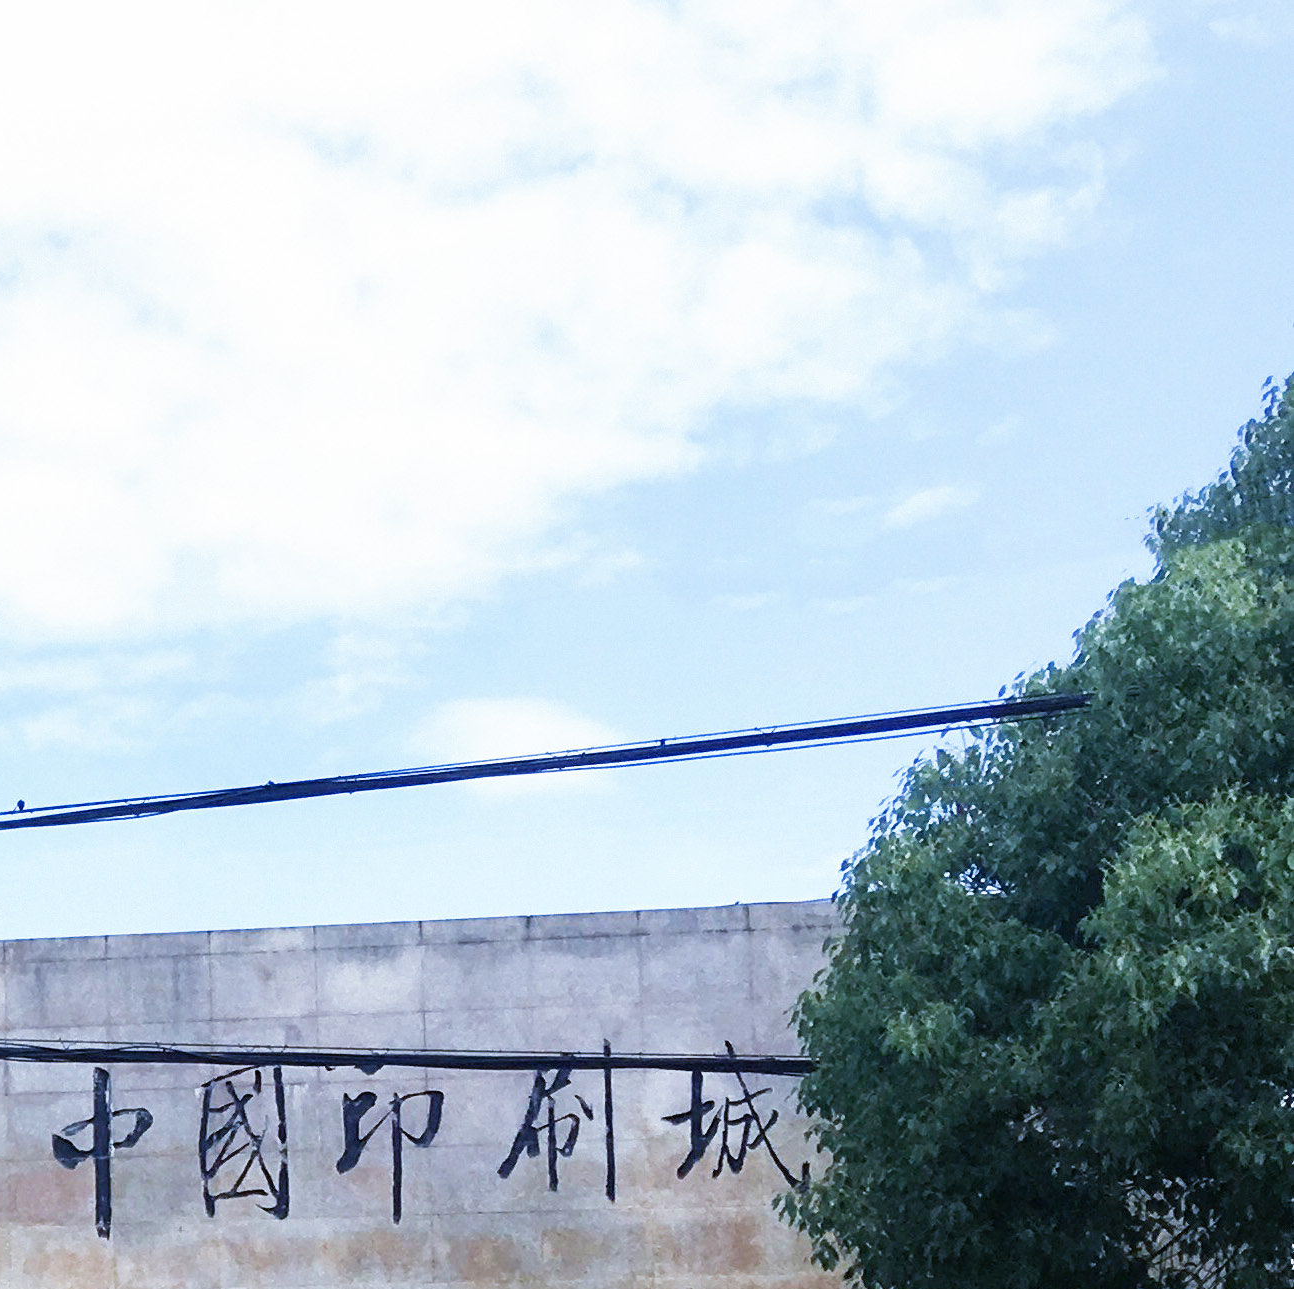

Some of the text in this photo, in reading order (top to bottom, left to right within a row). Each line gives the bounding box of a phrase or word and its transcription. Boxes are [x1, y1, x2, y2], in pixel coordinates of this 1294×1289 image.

[52, 1038, 811, 1240] 中國印刷城
